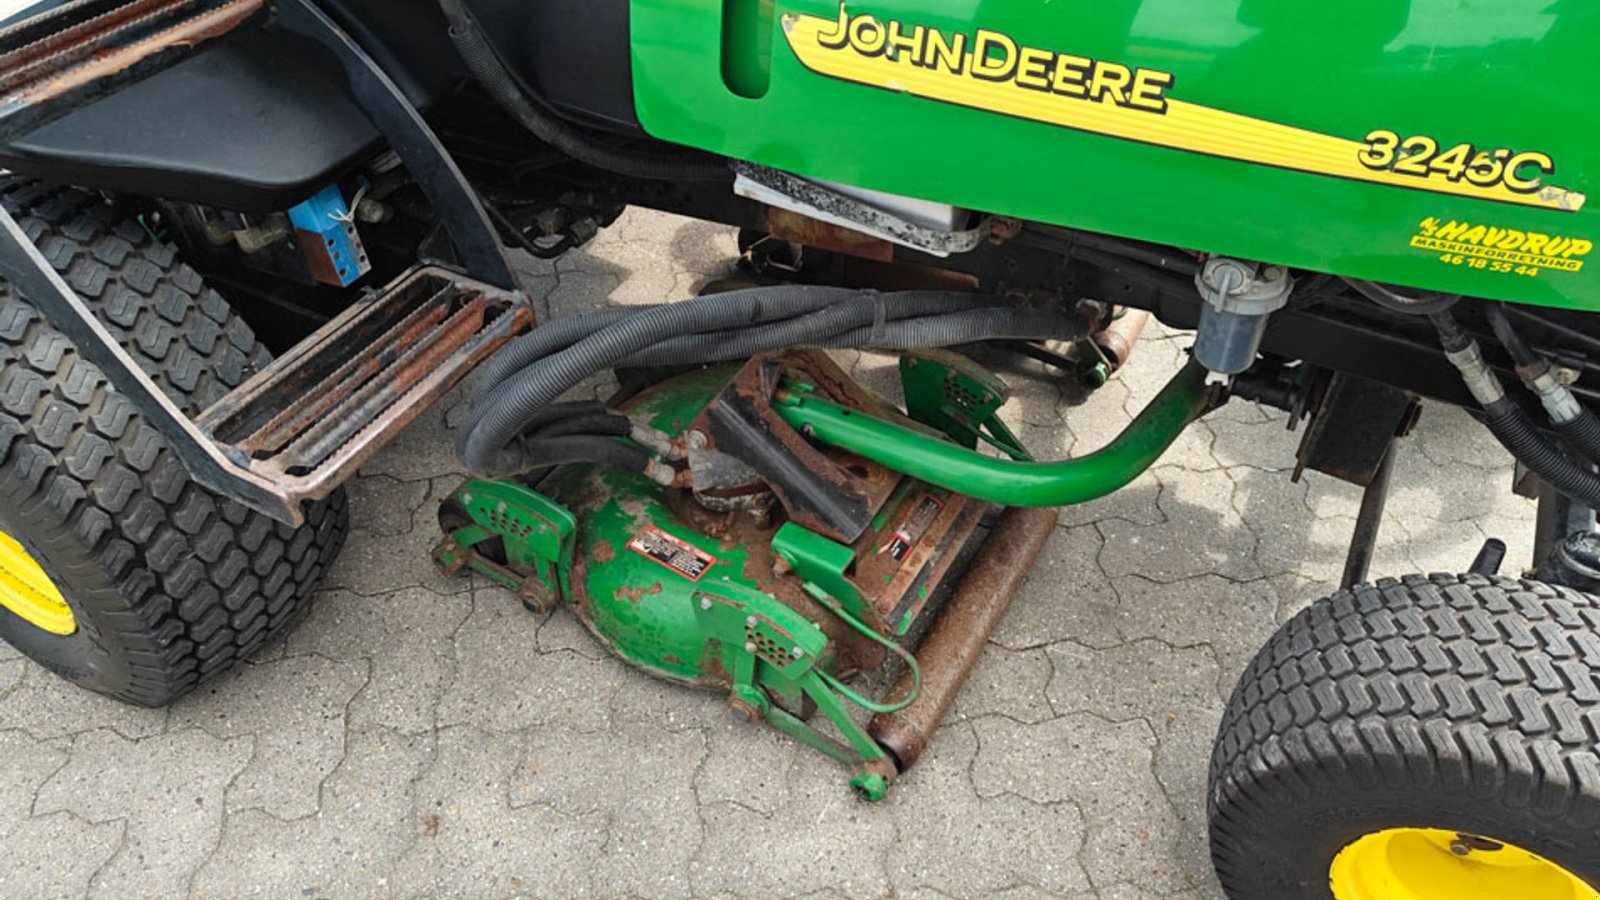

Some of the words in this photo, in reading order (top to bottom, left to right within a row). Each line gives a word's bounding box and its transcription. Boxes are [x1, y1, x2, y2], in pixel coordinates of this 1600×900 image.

[817, 1, 968, 76] JOHN
[969, 28, 1174, 115] DEERE
[1358, 129, 1555, 194] 3245C
[1414, 238, 1578, 270] MASKINFORRETNING
[1434, 219, 1592, 258] HAVDRUP
[1440, 253, 1464, 265] 46
[1467, 258, 1488, 269] 18
[1489, 261, 1513, 273] 55
[1515, 265, 1539, 277] 44
